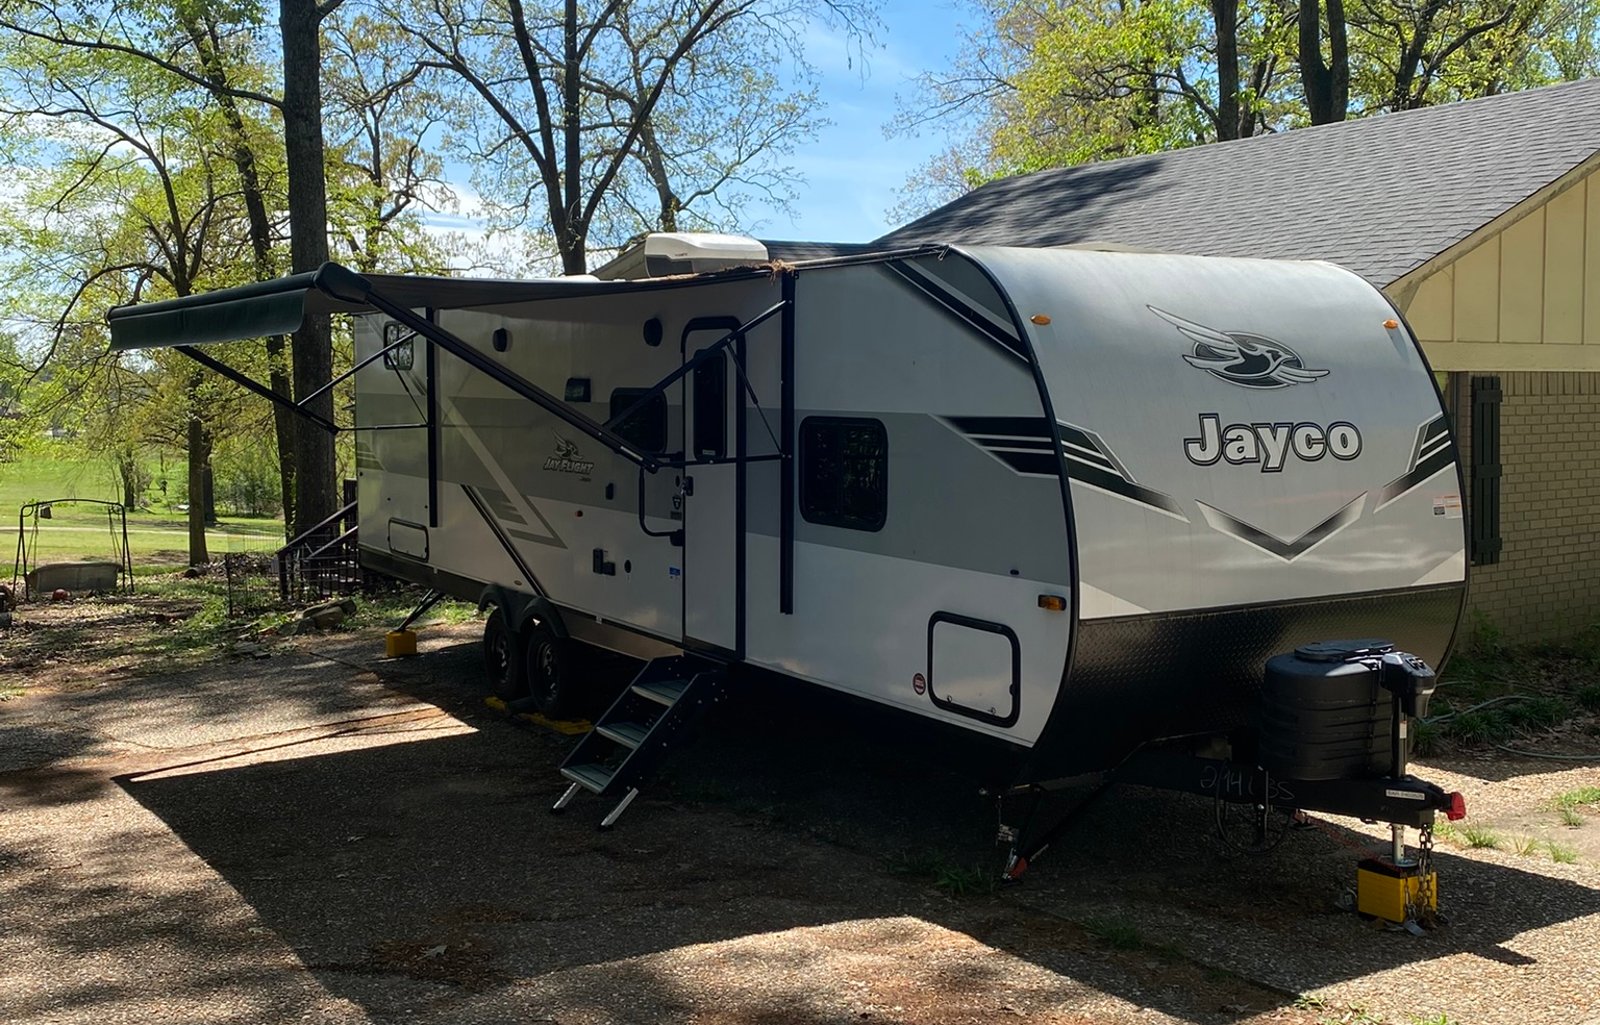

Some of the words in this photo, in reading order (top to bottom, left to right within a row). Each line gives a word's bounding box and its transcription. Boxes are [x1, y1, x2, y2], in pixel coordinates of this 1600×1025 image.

[1184, 413, 1363, 473] Jayco
[543, 456, 560, 471] JAY
[560, 458, 594, 475] FLIGHT
